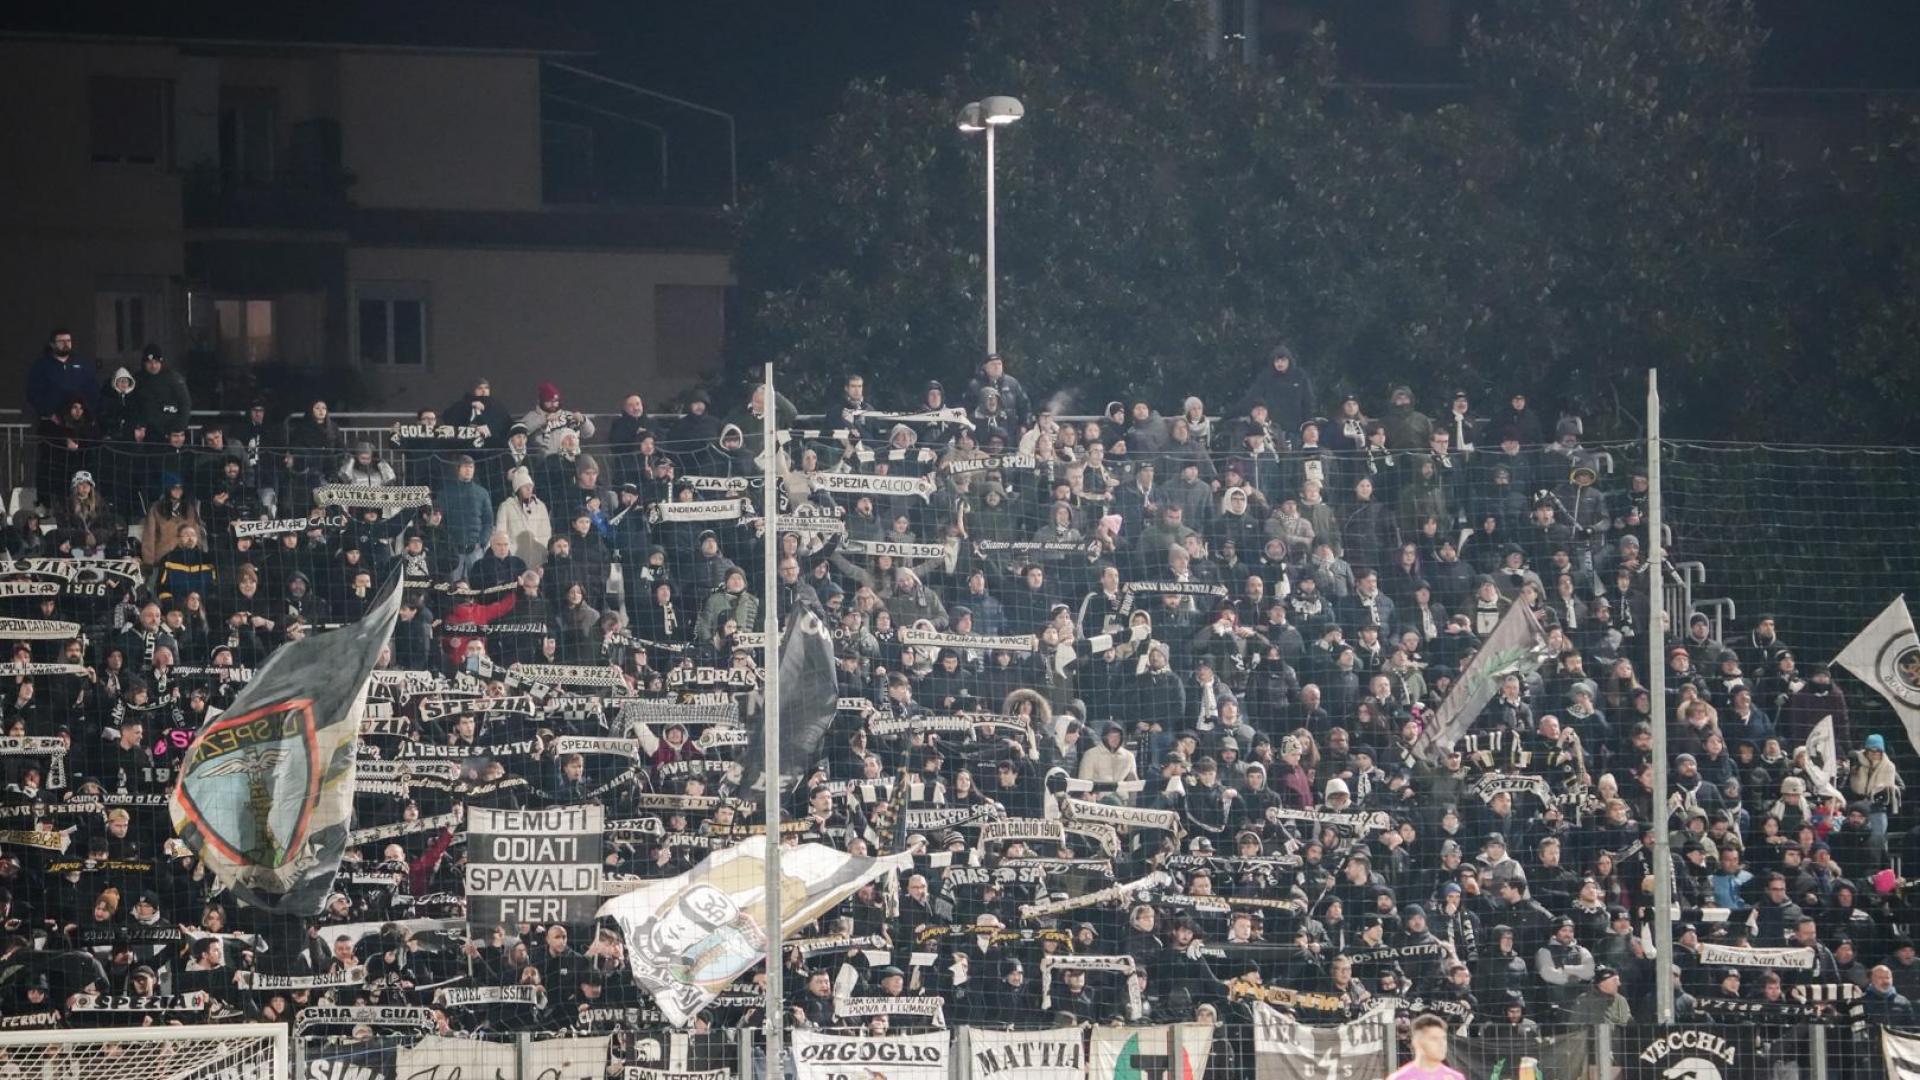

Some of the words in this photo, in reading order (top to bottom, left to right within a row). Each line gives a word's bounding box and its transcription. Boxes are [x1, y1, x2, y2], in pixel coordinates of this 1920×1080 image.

[829, 476, 870, 490] SPEZIA
[872, 478, 914, 492] CALCIO
[336, 491, 377, 501] ULTRAS
[239, 519, 286, 533] SPEZIA
[875, 543, 909, 556] DAL
[66, 582, 107, 597] 1906
[906, 631, 926, 640] CHI
[928, 633, 945, 642] LA
[980, 635, 997, 644] LA
[998, 636, 1031, 647] VINCE
[522, 666, 565, 678] ULTRAS
[490, 740, 533, 756] ALTA
[561, 740, 600, 751] SPEZIA
[488, 810, 587, 831] TEMUTI
[1075, 804, 1120, 819] SPEZIA
[1121, 811, 1168, 825] CALCIO
[604, 820, 656, 831] DEMO
[1008, 821, 1039, 837] CALCIO
[493, 838, 577, 862] ODIATI
[470, 867, 599, 891] SPAVALDI
[501, 899, 568, 923] FIERI
[1350, 947, 1399, 964] OSTRA
[1736, 954, 1746, 963] a
[1752, 954, 1778, 965] San
[1781, 955, 1806, 967] Siro
[94, 995, 186, 1010] SPEZIA
[304, 1008, 352, 1018] CHIA
[800, 1042, 941, 1062] ORGOGLIO
[1640, 1031, 1736, 1066] VECCHIA
[976, 1042, 1081, 1076] MATTIA
